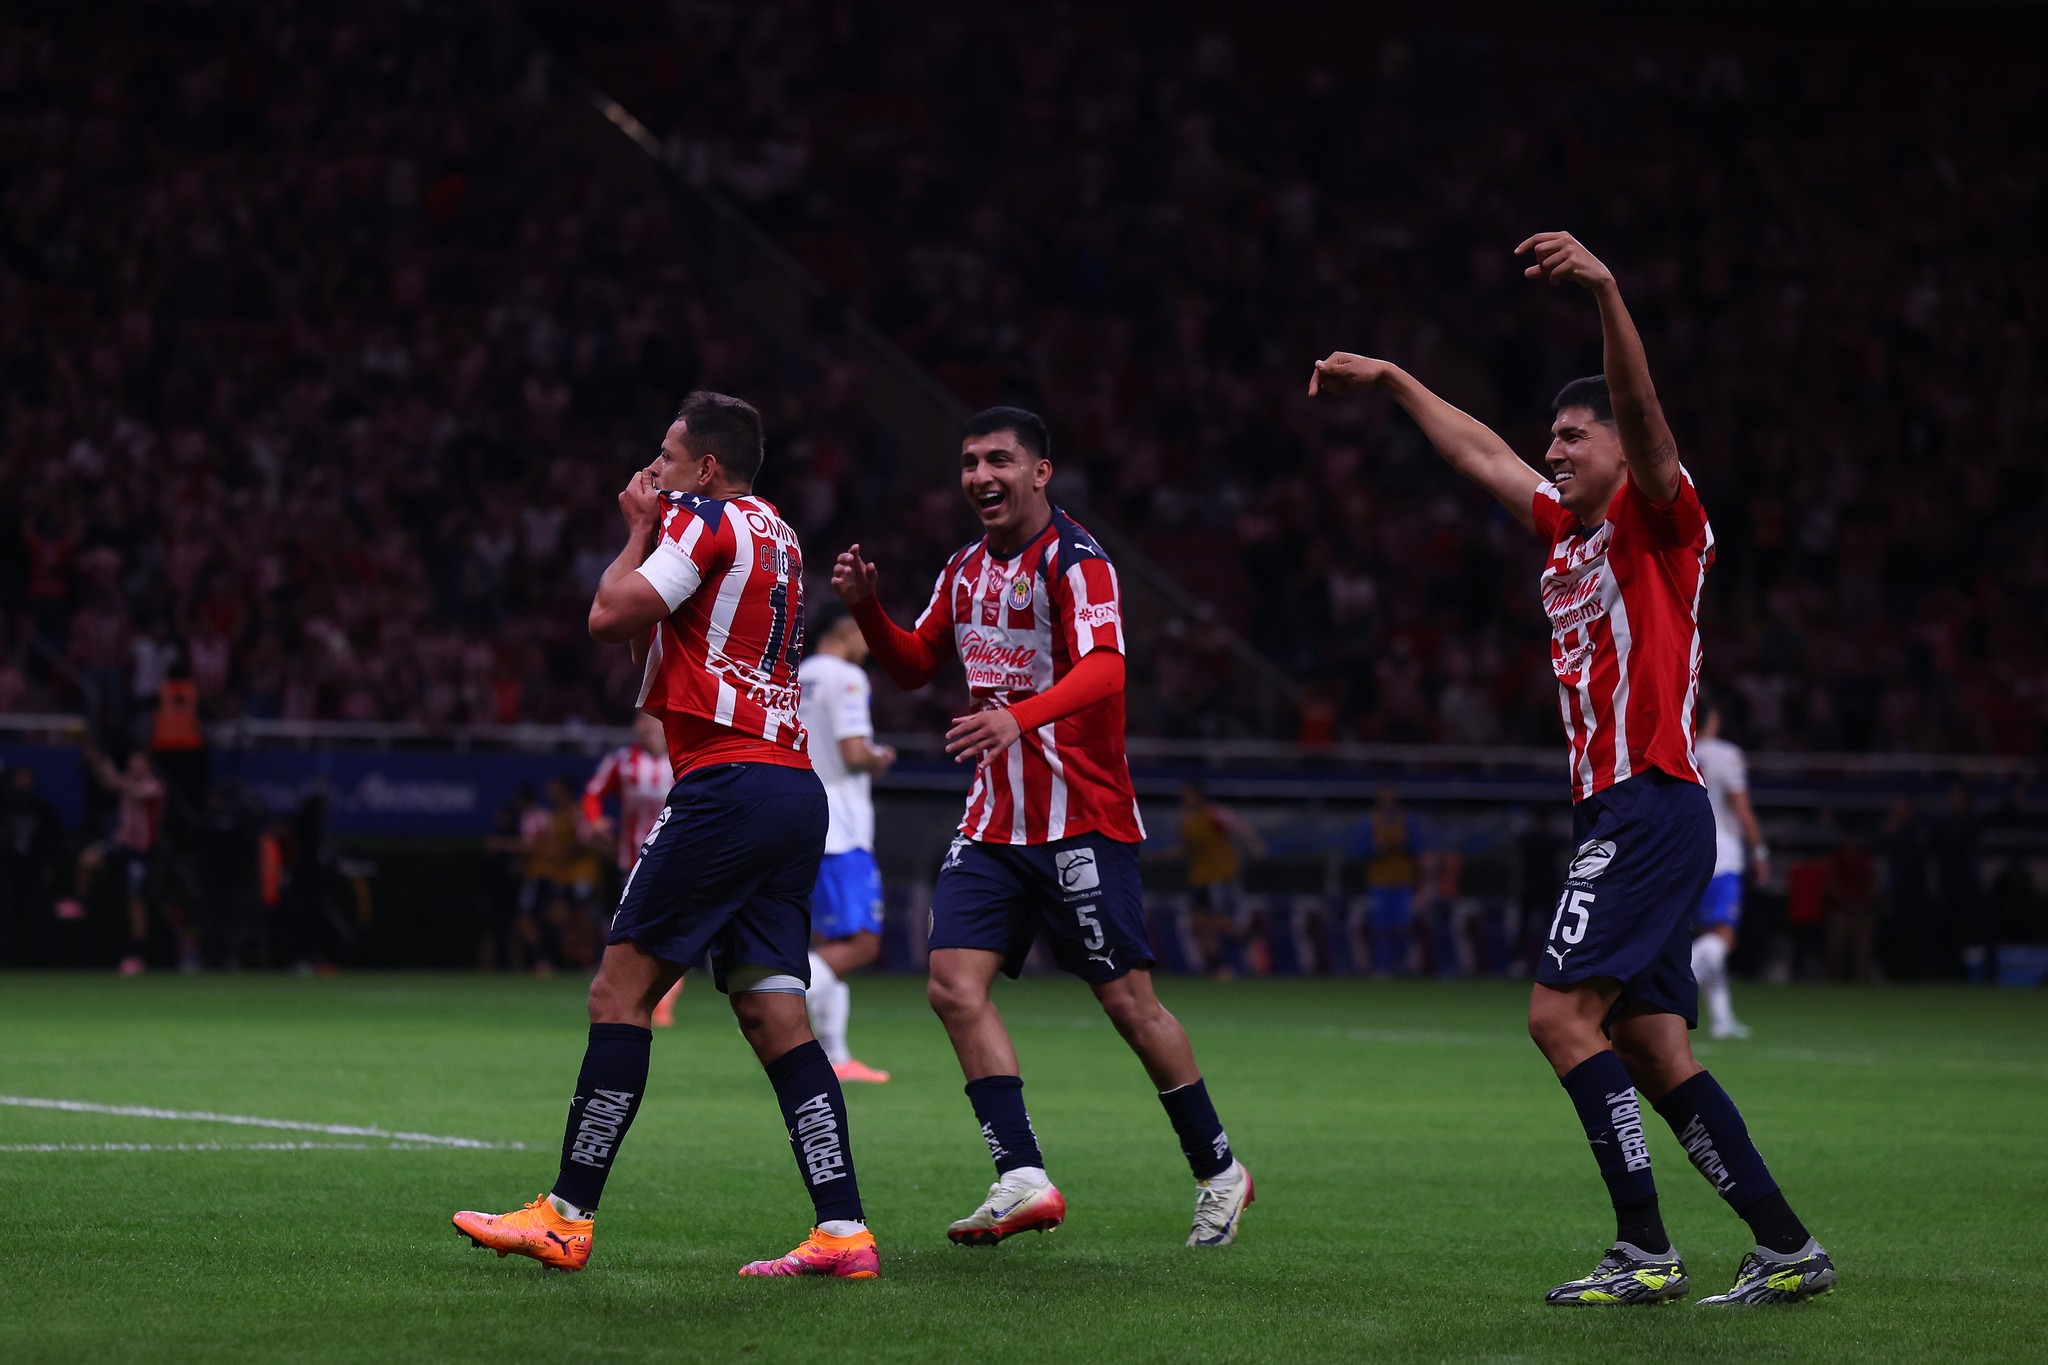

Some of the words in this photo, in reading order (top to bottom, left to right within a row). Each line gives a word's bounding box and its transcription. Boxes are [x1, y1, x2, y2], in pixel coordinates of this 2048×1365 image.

[1552, 598, 1604, 634] liente.mx
[1076, 904, 1105, 951] 5
[1549, 889, 1596, 945] 15
[571, 1088, 635, 1169] PERDURA
[795, 1092, 848, 1186] PERDURA
[1606, 1086, 1651, 1173] PERDURA
